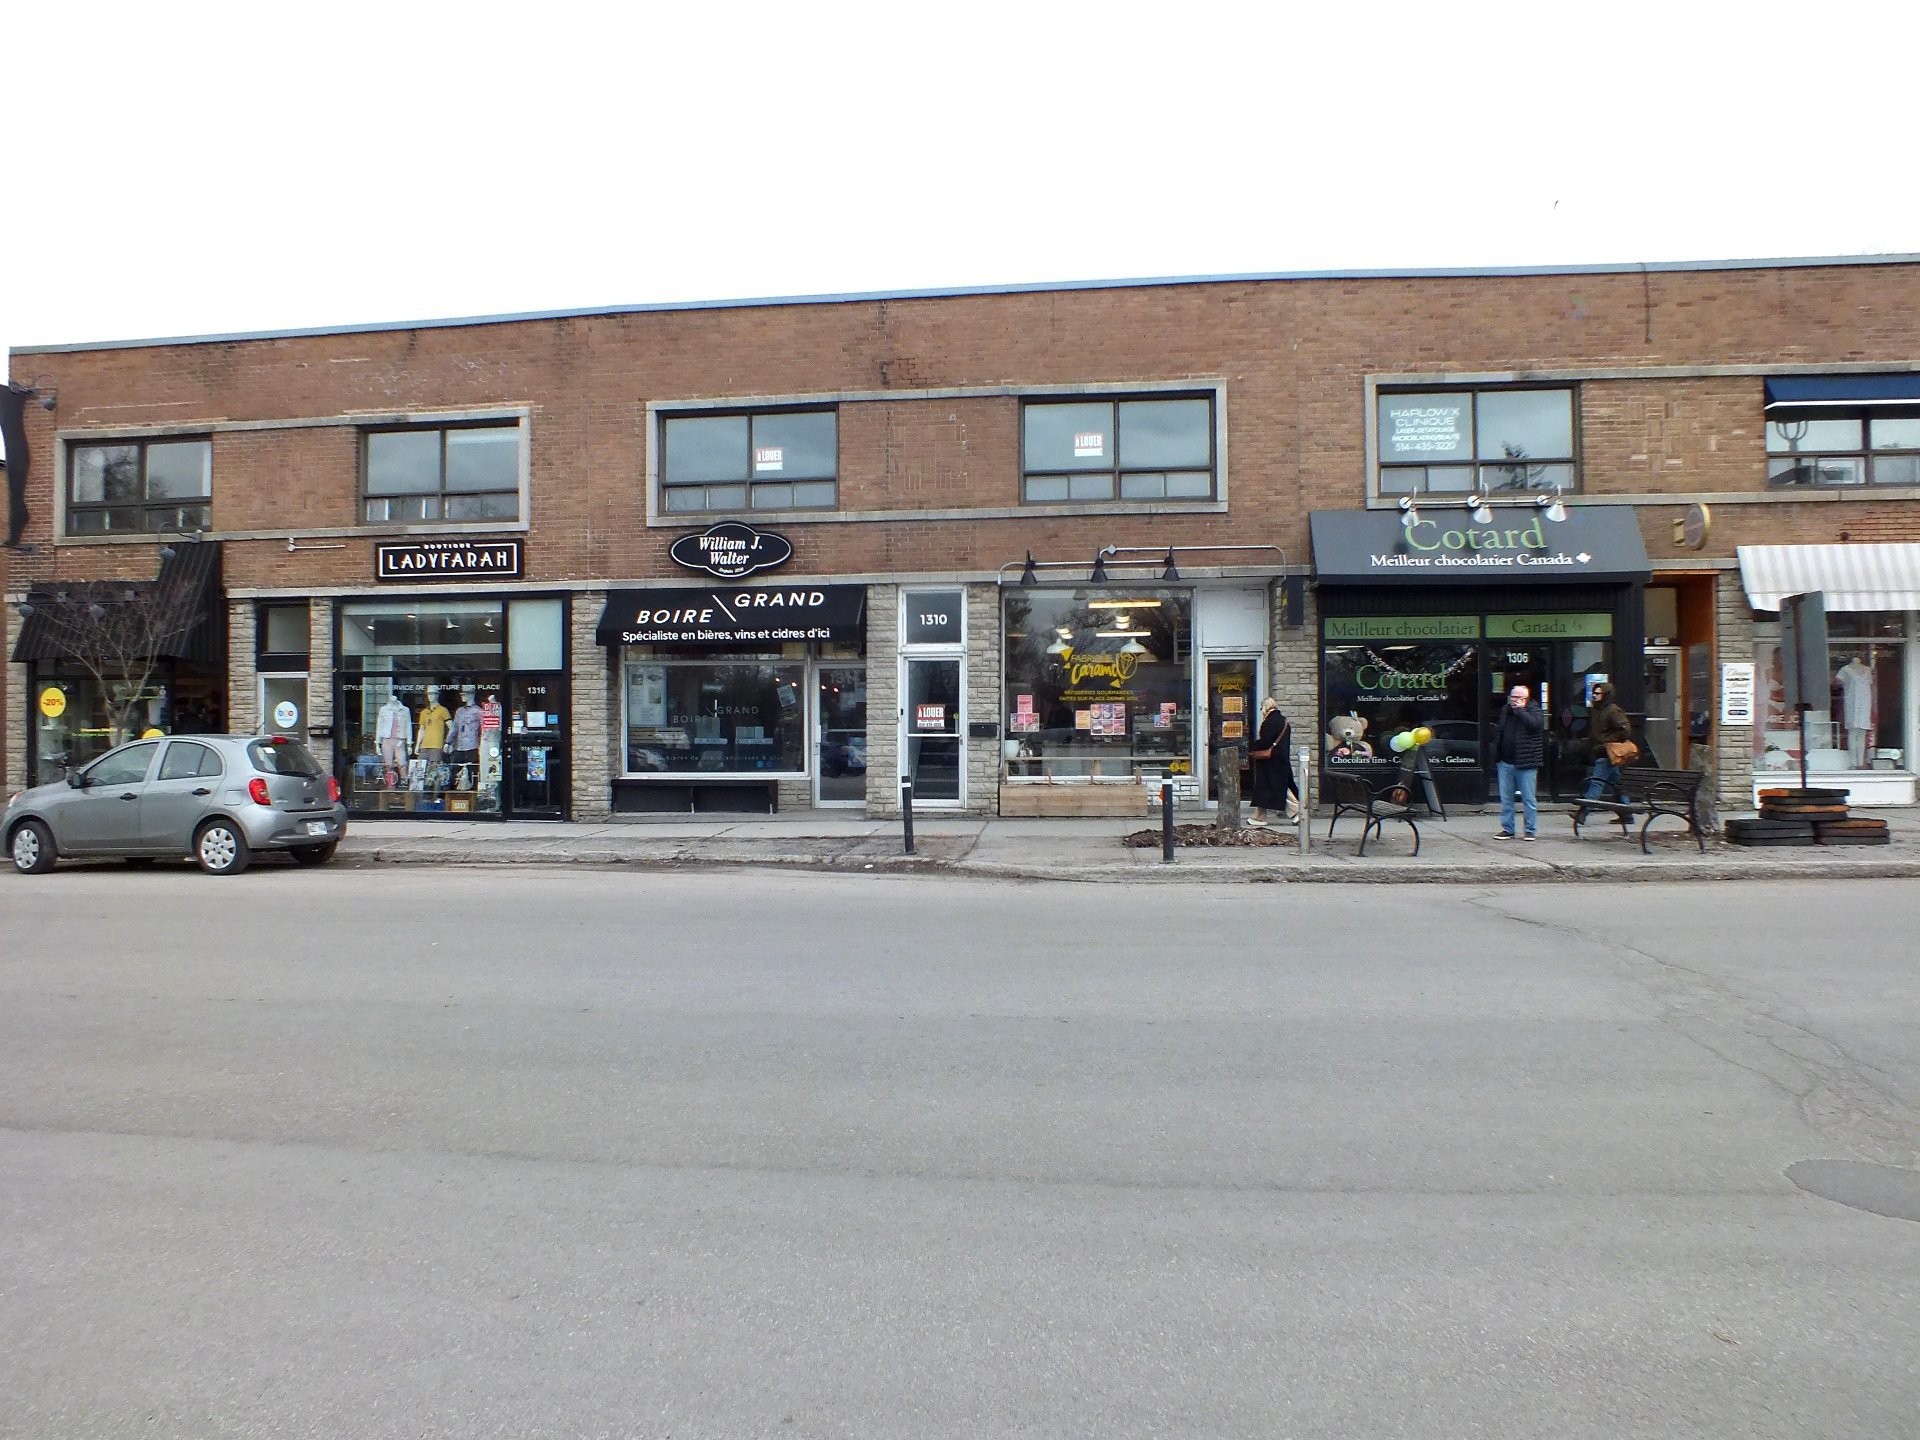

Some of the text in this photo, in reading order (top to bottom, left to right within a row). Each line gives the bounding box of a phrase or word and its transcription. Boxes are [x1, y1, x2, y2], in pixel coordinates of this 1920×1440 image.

[1390, 408, 1448, 417] HARLOW
[1395, 417, 1455, 426] CLINIQUE
[1080, 435, 1102, 447] LOUER
[762, 450, 782, 461] LOUER
[1404, 517, 1548, 550] Cotard
[699, 536, 763, 550] William J.
[388, 551, 507, 570] LADYFARAH
[710, 552, 750, 564] Walter
[1371, 552, 1574, 567] Meilleur chocolatier Canada
[734, 592, 825, 608] GRAND
[636, 609, 714, 624] BOIRE
[919, 614, 948, 626] 1310
[1331, 620, 1566, 637] Meilleur chocolatier Canada
[622, 628, 831, 643] Spécialiste en bières, vins et cidres d'ici
[1507, 652, 1529, 663] 1306
[1356, 663, 1447, 690] Cotard
[717, 706, 759, 715] GRAND
[923, 706, 944, 718] LOUER
[1331, 756, 1370, 764] Chocolats
[1372, 756, 1387, 764] fins
[1445, 756, 1476, 764] Gelatos
